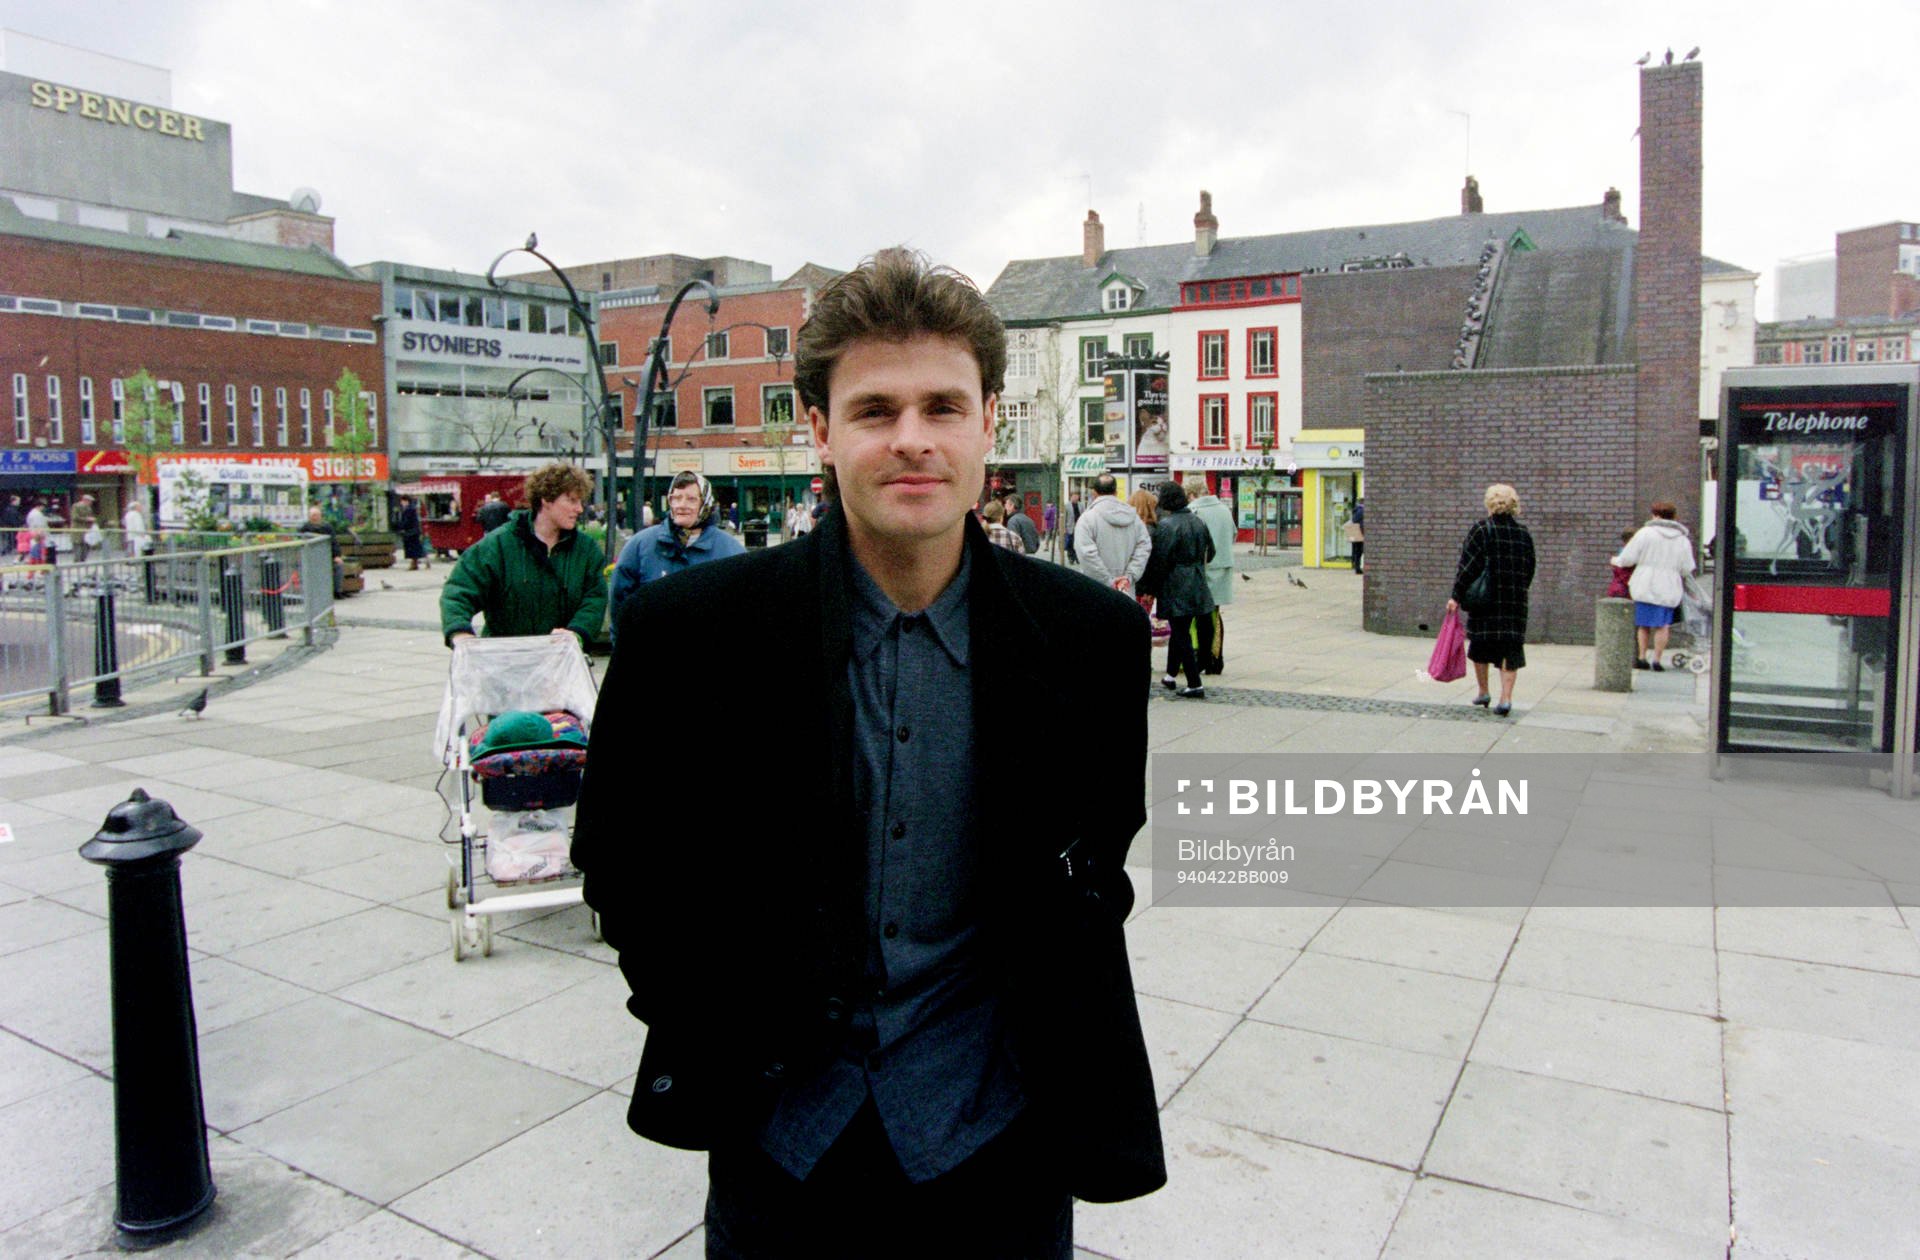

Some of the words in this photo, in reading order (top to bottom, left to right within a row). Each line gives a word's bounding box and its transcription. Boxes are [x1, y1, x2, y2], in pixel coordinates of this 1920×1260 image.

[31, 81, 205, 142] SPENCER
[403, 331, 502, 358] STONIERS
[1763, 411, 1869, 434] Telephone
[29, 452, 69, 463] MOSS
[312, 458, 376, 477] STORES
[1191, 457, 1207, 467] THE
[1212, 457, 1244, 467] TRAVEL
